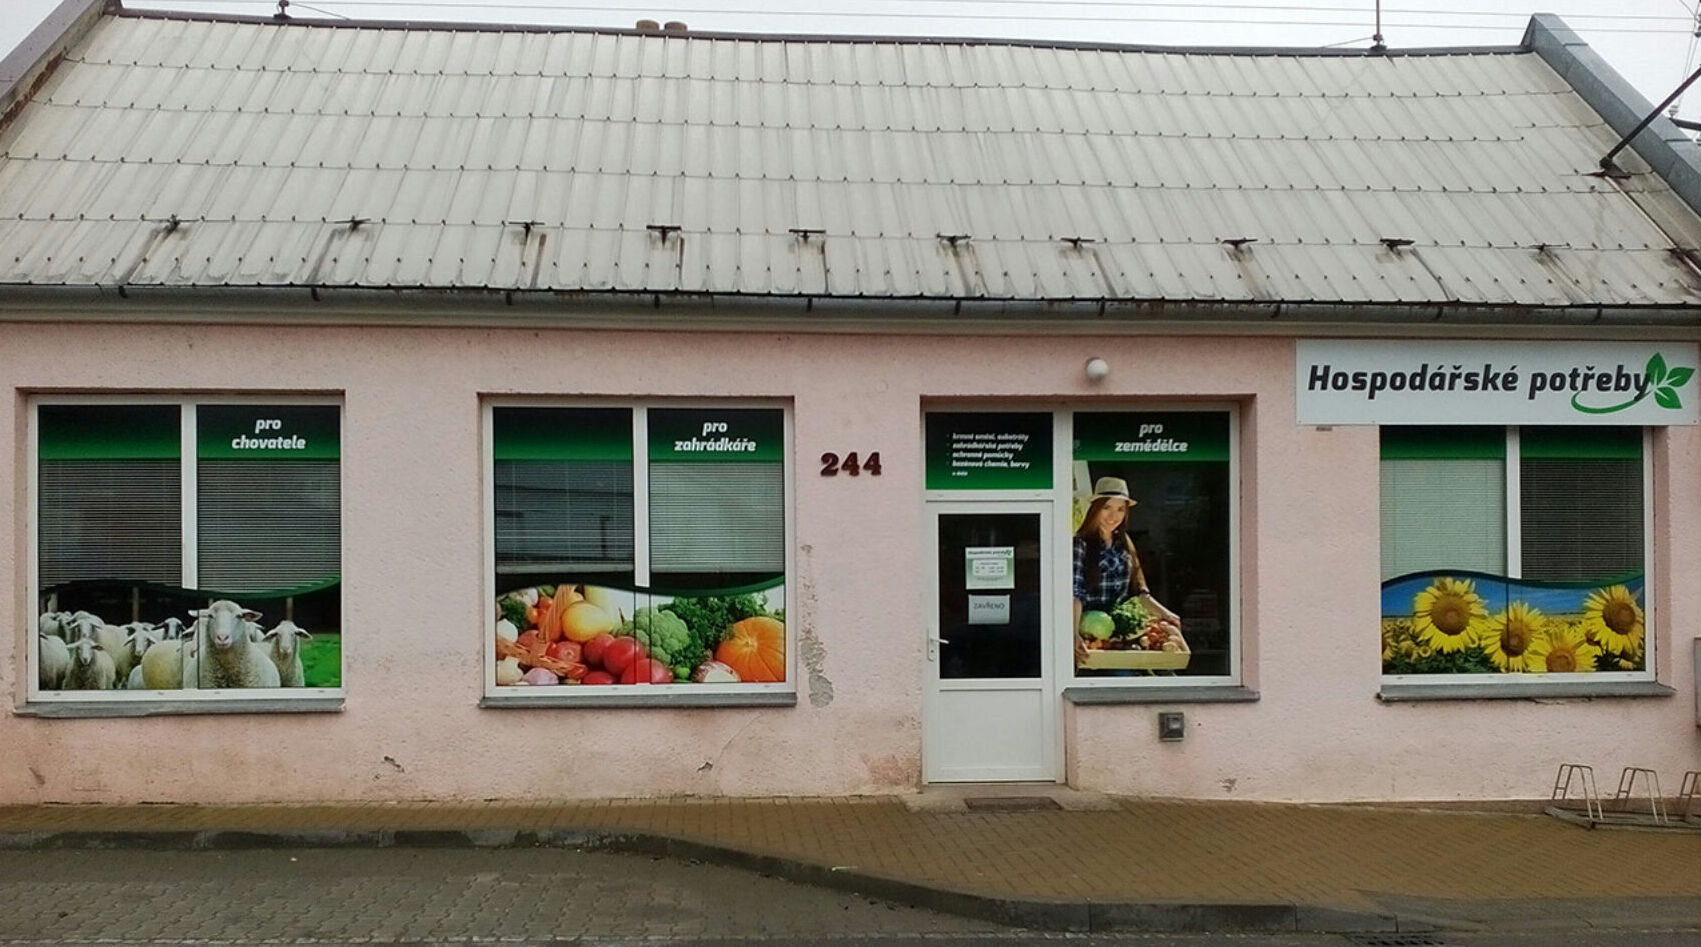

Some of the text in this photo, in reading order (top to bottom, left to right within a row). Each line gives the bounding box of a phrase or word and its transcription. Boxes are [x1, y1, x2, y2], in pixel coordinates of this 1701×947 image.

[1308, 363, 1651, 402] Hospodářské potřeby
[254, 419, 282, 434] pro
[702, 422, 728, 437] pro
[1138, 423, 1164, 438] pro
[231, 434, 306, 449] chovatele
[674, 437, 757, 452] zahrádkáře
[1114, 438, 1189, 452] zemědělce
[820, 451, 882, 477] 244
[973, 601, 1005, 610] ZAVŘENO
